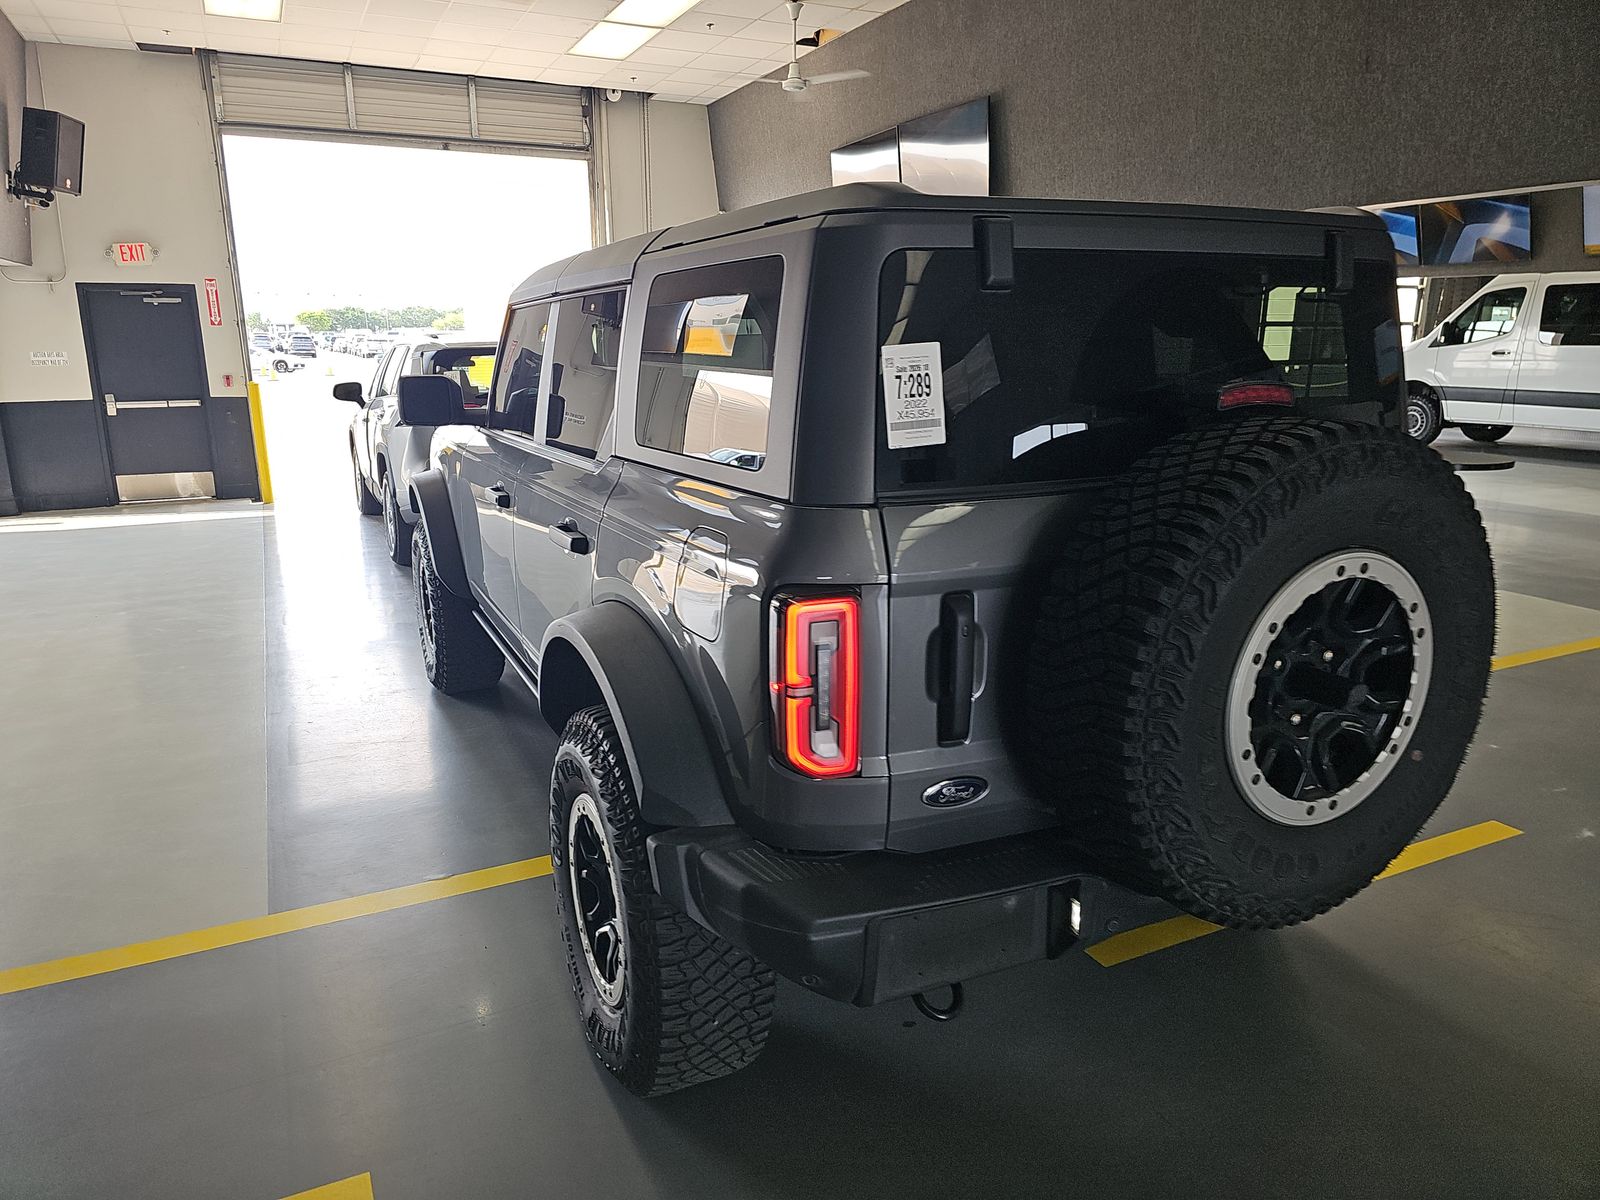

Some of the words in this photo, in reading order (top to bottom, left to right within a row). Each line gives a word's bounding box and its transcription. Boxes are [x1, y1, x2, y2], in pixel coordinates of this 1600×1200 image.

[119, 244, 145, 262] EXIT
[904, 398, 928, 410] 2022
[939, 785, 975, 803] Ford
